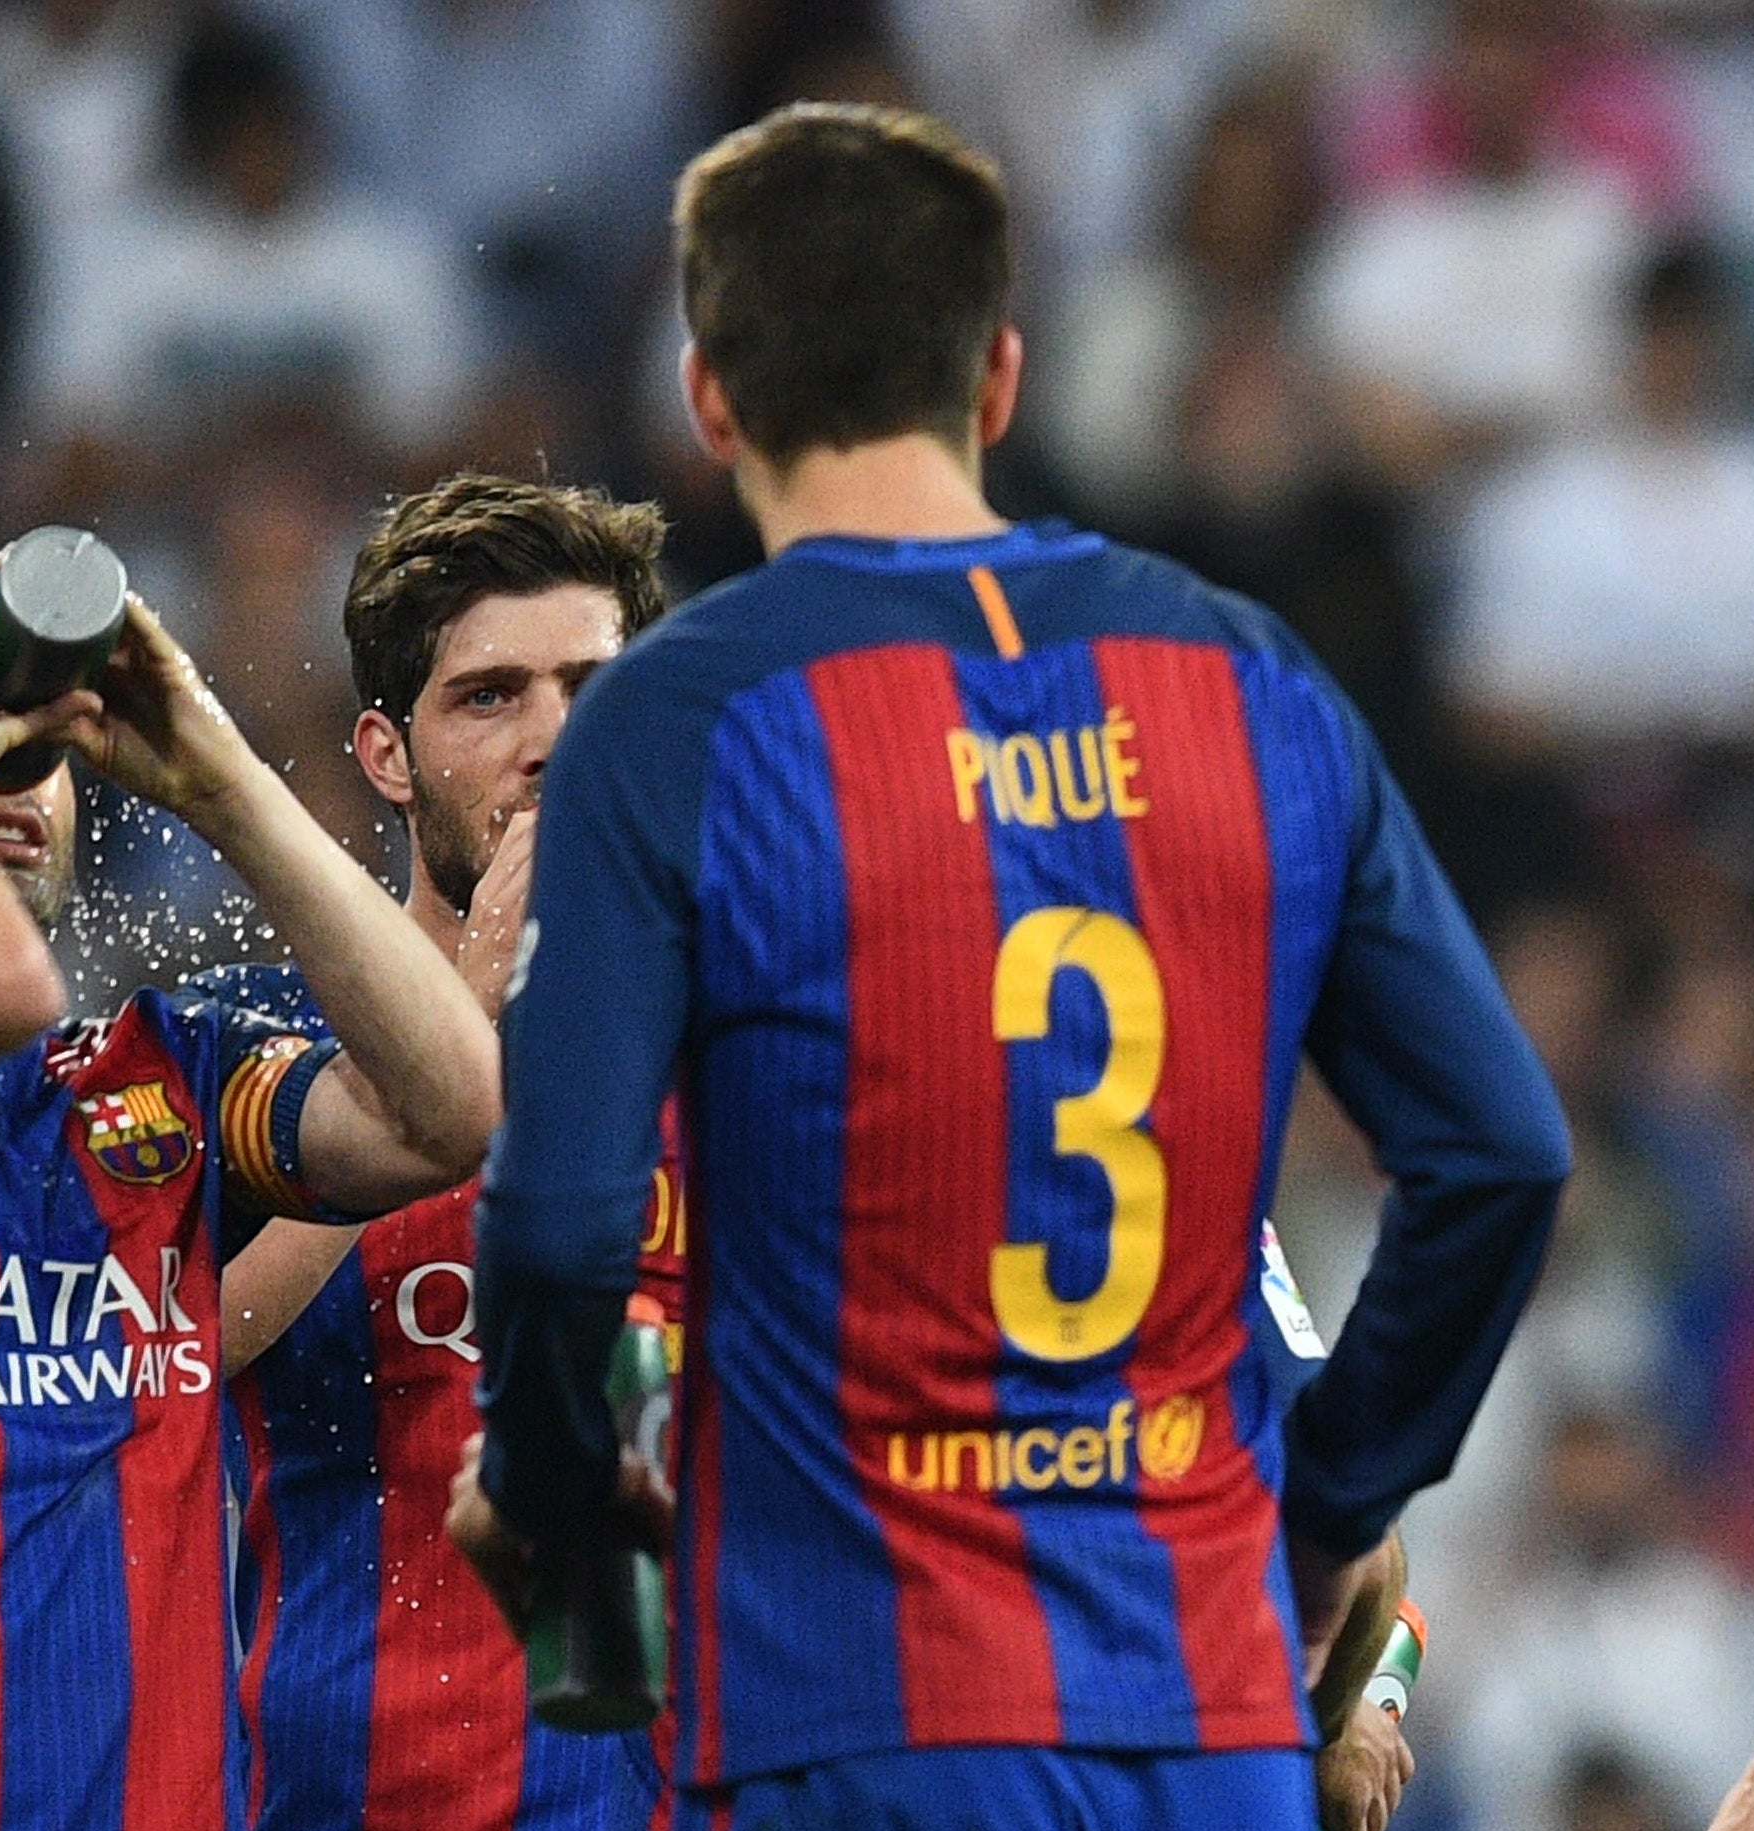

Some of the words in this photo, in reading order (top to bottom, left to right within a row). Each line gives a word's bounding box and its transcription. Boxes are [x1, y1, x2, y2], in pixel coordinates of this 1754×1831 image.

[948, 706, 1149, 829] PIQUÉ
[991, 906, 1168, 1362] 3
[887, 1399, 1134, 1492] unicef
